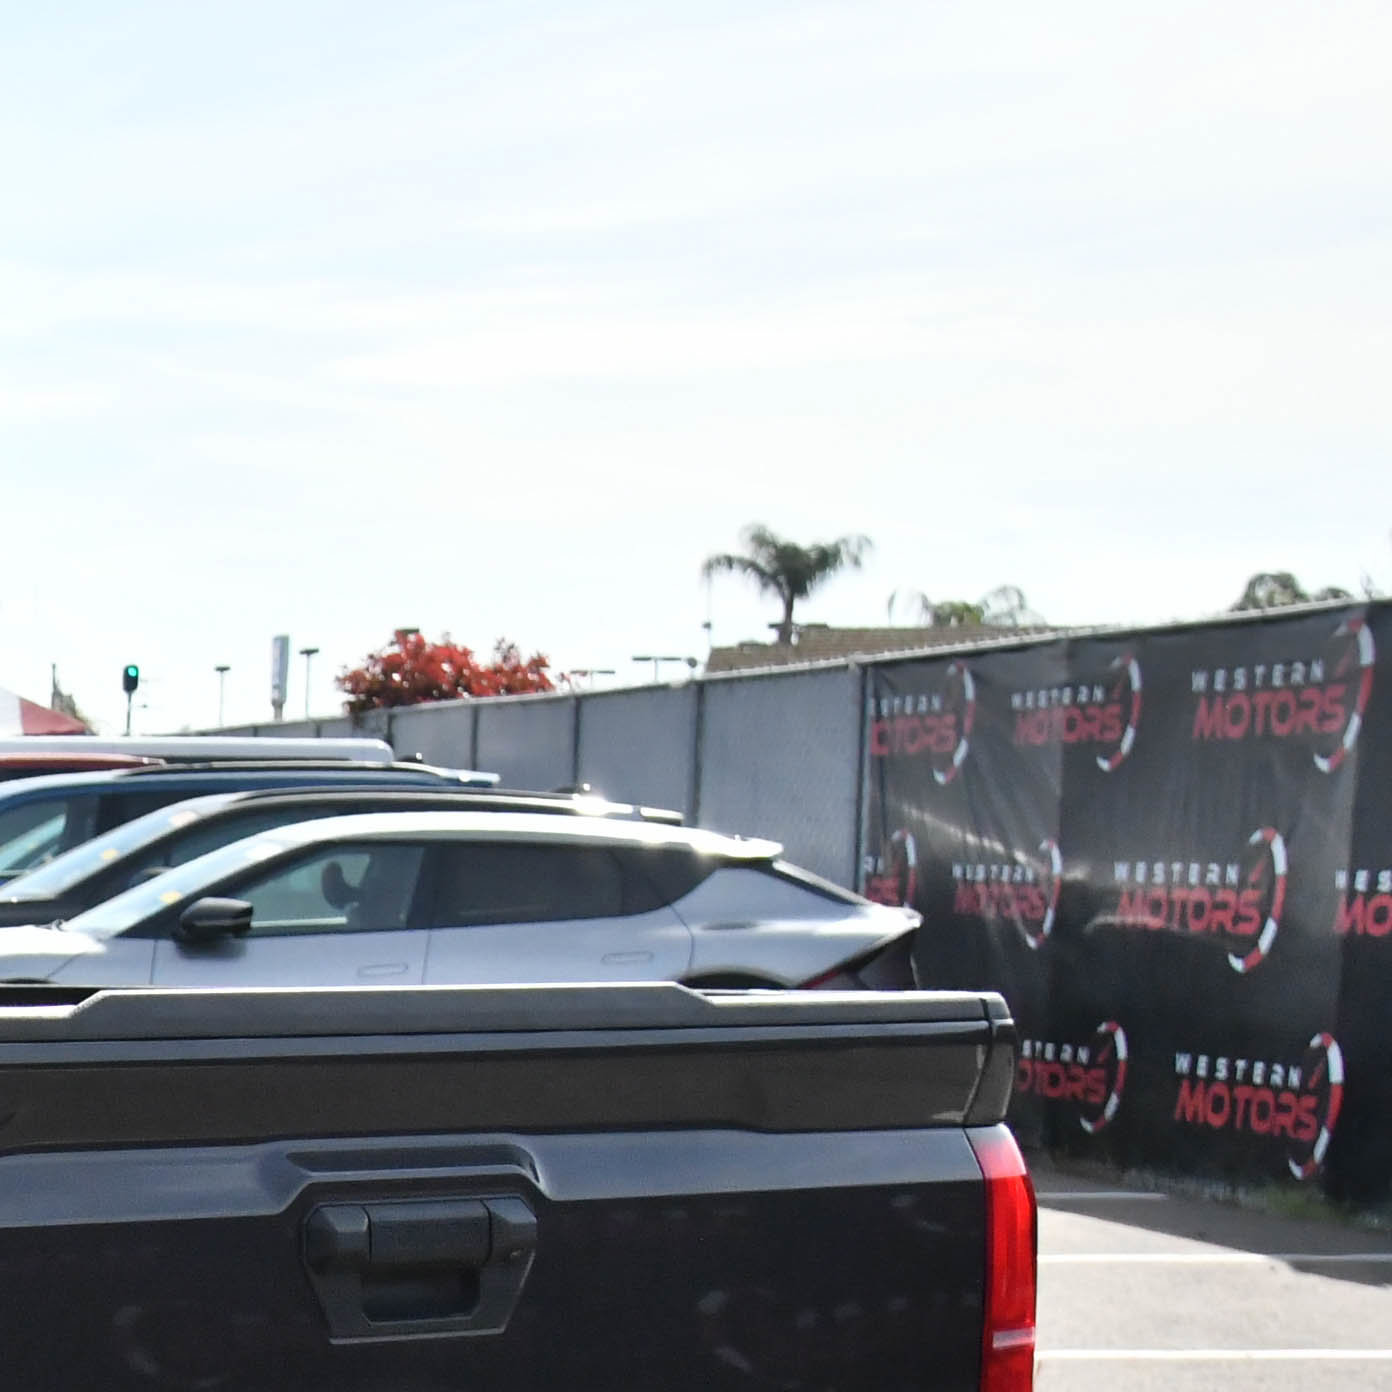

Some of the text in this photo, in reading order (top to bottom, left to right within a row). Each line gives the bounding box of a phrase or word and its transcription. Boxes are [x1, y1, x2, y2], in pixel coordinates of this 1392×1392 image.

[1192, 658, 1325, 692] WESTERN
[1192, 685, 1350, 740] MOTORS
[1114, 861, 1241, 887] WESTERN
[1115, 886, 1262, 936] MOTORS
[1175, 1051, 1303, 1092] WESTERN
[1174, 1078, 1318, 1143] MOTORS
